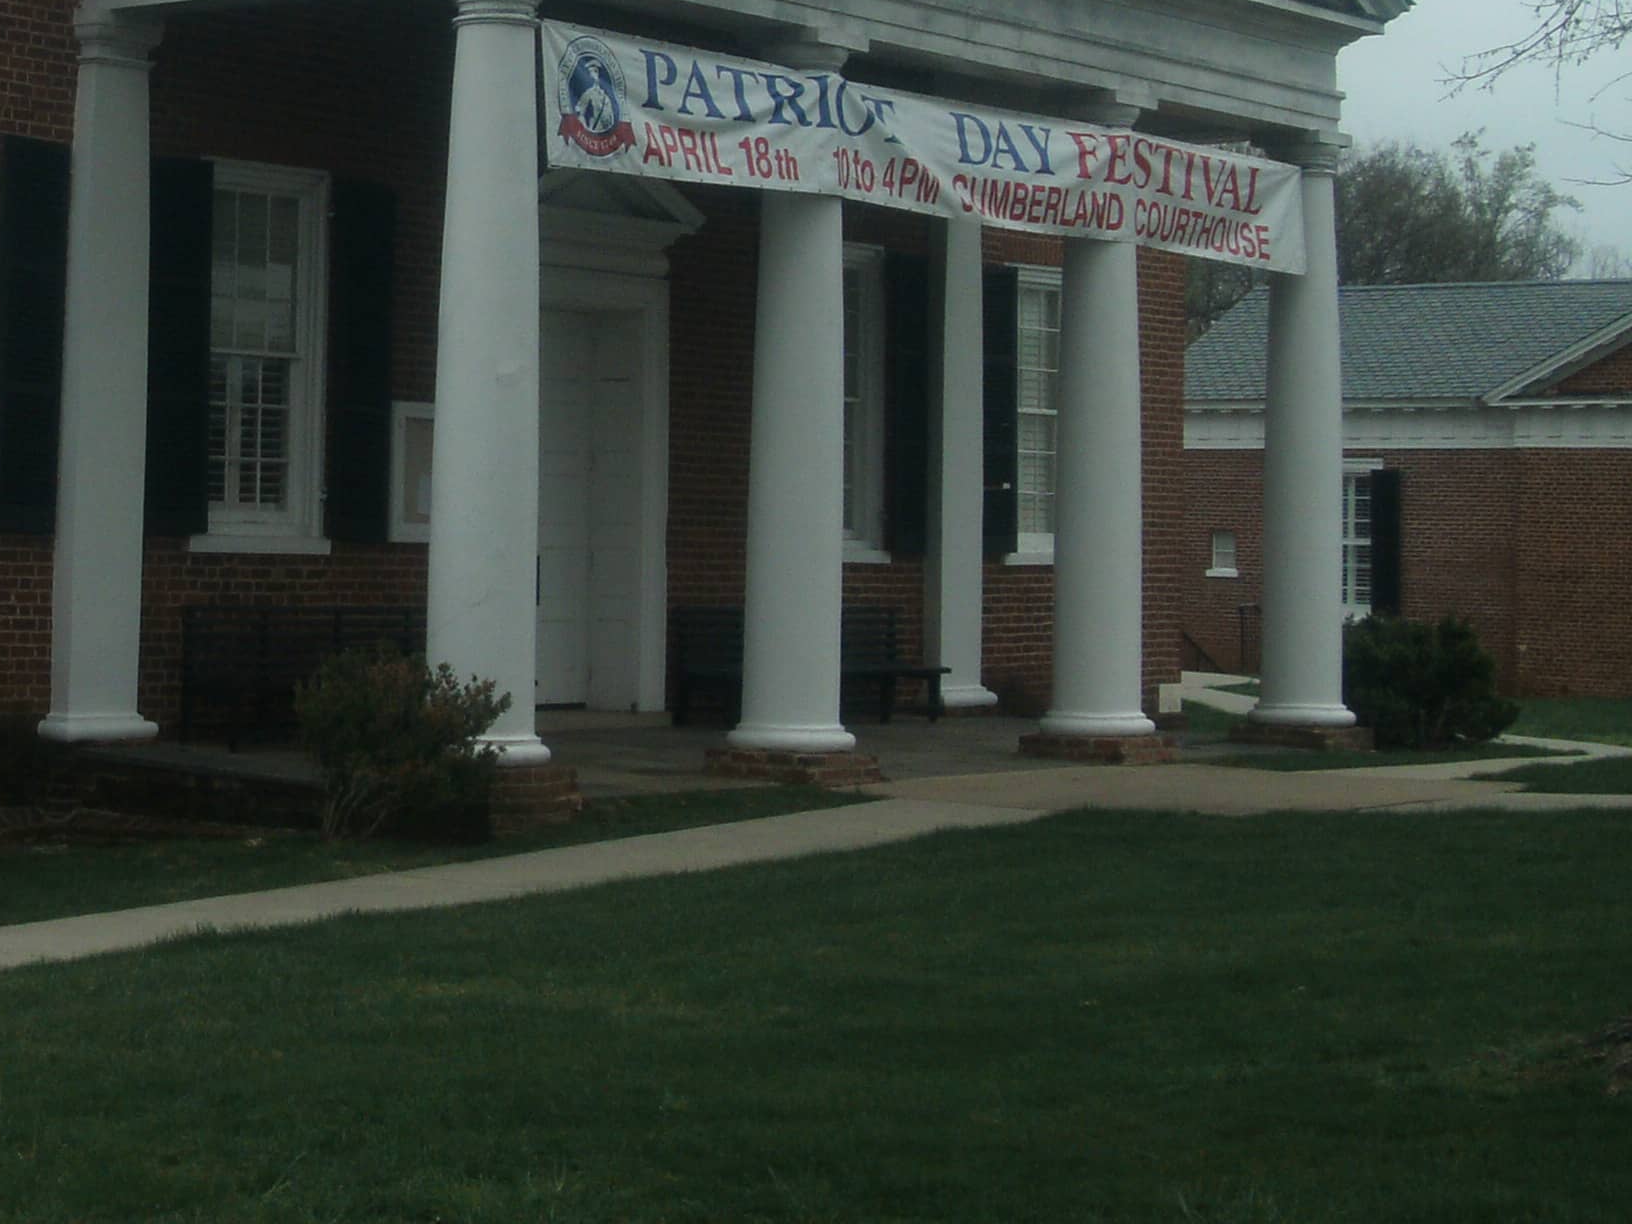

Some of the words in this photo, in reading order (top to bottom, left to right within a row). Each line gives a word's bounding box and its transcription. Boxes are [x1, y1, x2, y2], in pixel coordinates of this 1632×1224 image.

[643, 122, 733, 175] APRIL
[738, 136, 800, 181] 18th
[832, 146, 850, 189] 10
[853, 149, 874, 193] to
[1134, 198, 1272, 261] COURTHOUSE
[949, 111, 1056, 175] DAY
[1066, 131, 1263, 215] FESTIVAL
